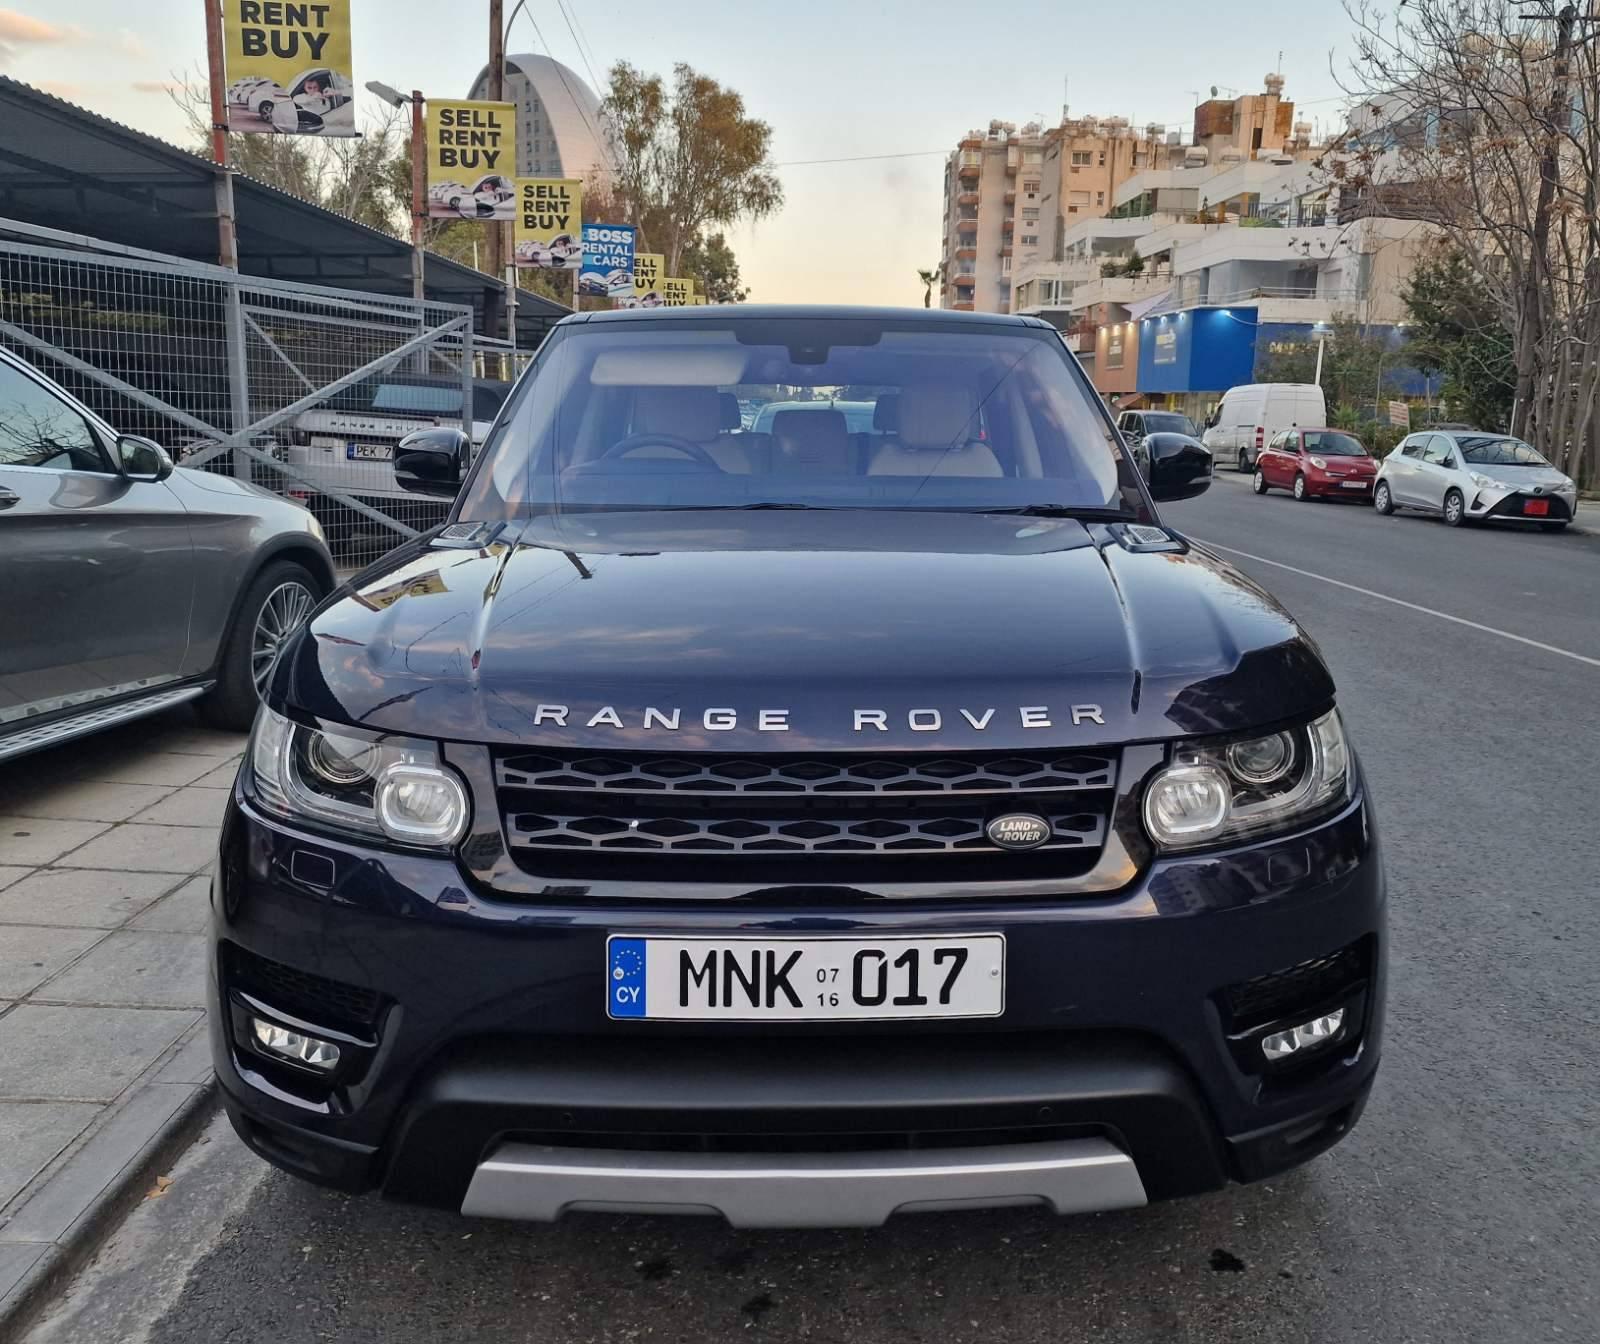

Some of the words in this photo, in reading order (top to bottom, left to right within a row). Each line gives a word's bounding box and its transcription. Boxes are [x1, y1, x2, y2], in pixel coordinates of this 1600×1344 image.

[240, 0, 330, 28] RENT
[241, 27, 331, 61] BUY
[439, 108, 502, 129] SELL
[439, 129, 501, 148] RENT
[439, 148, 501, 169] BUY
[524, 185, 570, 199] SELL
[524, 200, 570, 213] RENT
[523, 214, 570, 231] BUY
[588, 228, 633, 244] BOSS
[582, 242, 632, 257] RENTAL
[592, 255, 628, 268] CARS
[633, 258, 657, 268] ELL
[633, 269, 657, 278] ENT
[634, 278, 657, 289] UY
[663, 291, 687, 300] ENT
[356, 446, 377, 457] PEK
[533, 703, 790, 732] RANGE
[853, 703, 1106, 732] ROVER
[1000, 821, 1031, 831] LAND
[1002, 831, 1041, 841] ROVER
[679, 949, 804, 1009] MNK
[816, 967, 840, 983] 07
[852, 947, 969, 1007] 017
[616, 986, 641, 1004] CY
[817, 993, 840, 1008] 16
